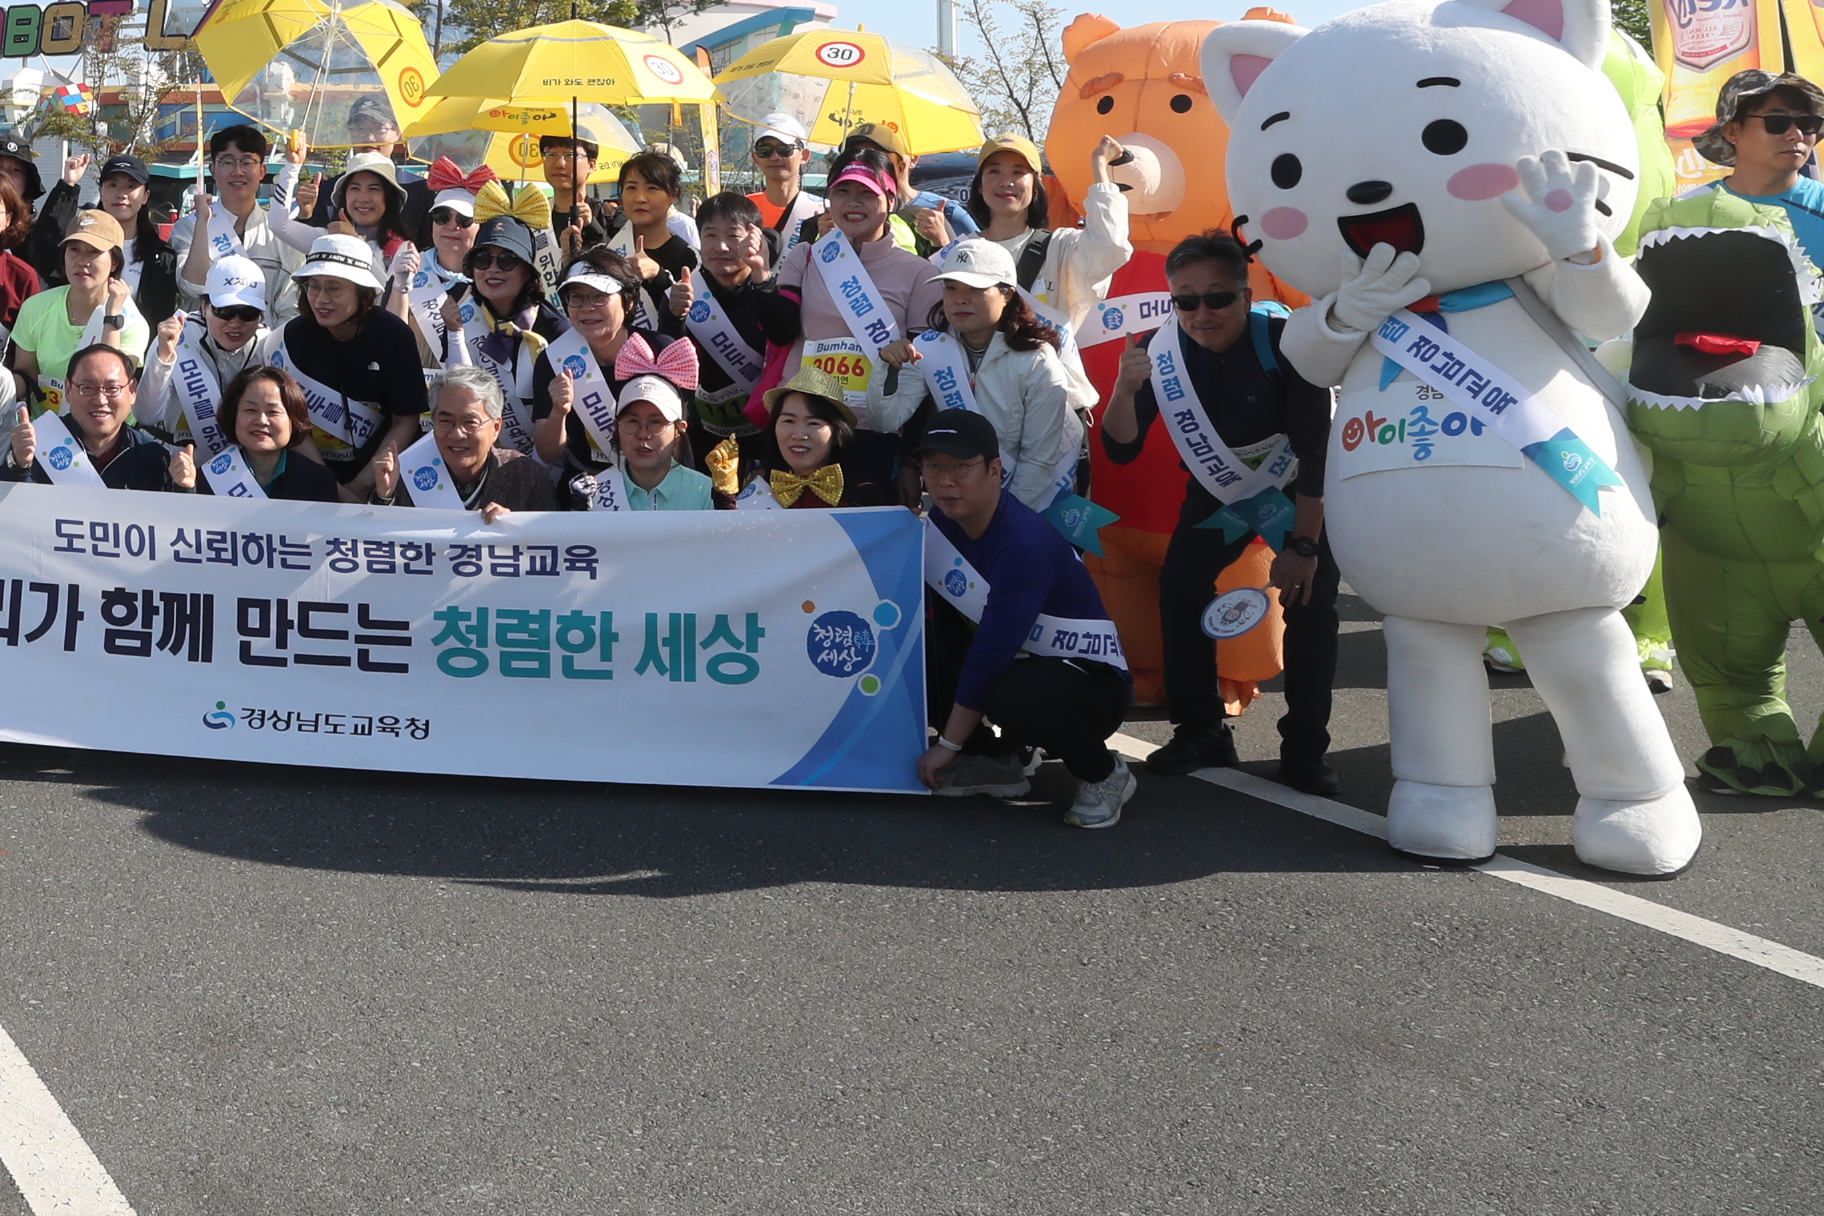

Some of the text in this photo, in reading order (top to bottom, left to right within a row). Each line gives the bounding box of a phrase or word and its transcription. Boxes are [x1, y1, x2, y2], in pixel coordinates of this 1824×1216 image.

[651, 61, 674, 76] 30
[827, 48, 853, 61] 30
[542, 78, 615, 86] 비가 와도 괜찮아
[840, 275, 874, 319] 청렴
[816, 339, 863, 353] Bumhan
[813, 356, 865, 377] 3066
[1377, 315, 1519, 417] 렴 경남교육
[179, 358, 215, 421] 모두를
[1415, 384, 1444, 402] 경남
[581, 390, 617, 442] 모두
[1156, 350, 1243, 488] 청렴 경남교육
[53, 518, 599, 580] 도민이 신뢰하는 청렴한 경남교육
[99, 586, 215, 664] 함께
[236, 596, 413, 674] 만드는
[430, 605, 620, 682] 청렴한
[633, 611, 767, 685] 세상
[1051, 628, 1122, 659] 경남교
[816, 648, 863, 672] 세상
[239, 707, 432, 741] 경상남도교육청
